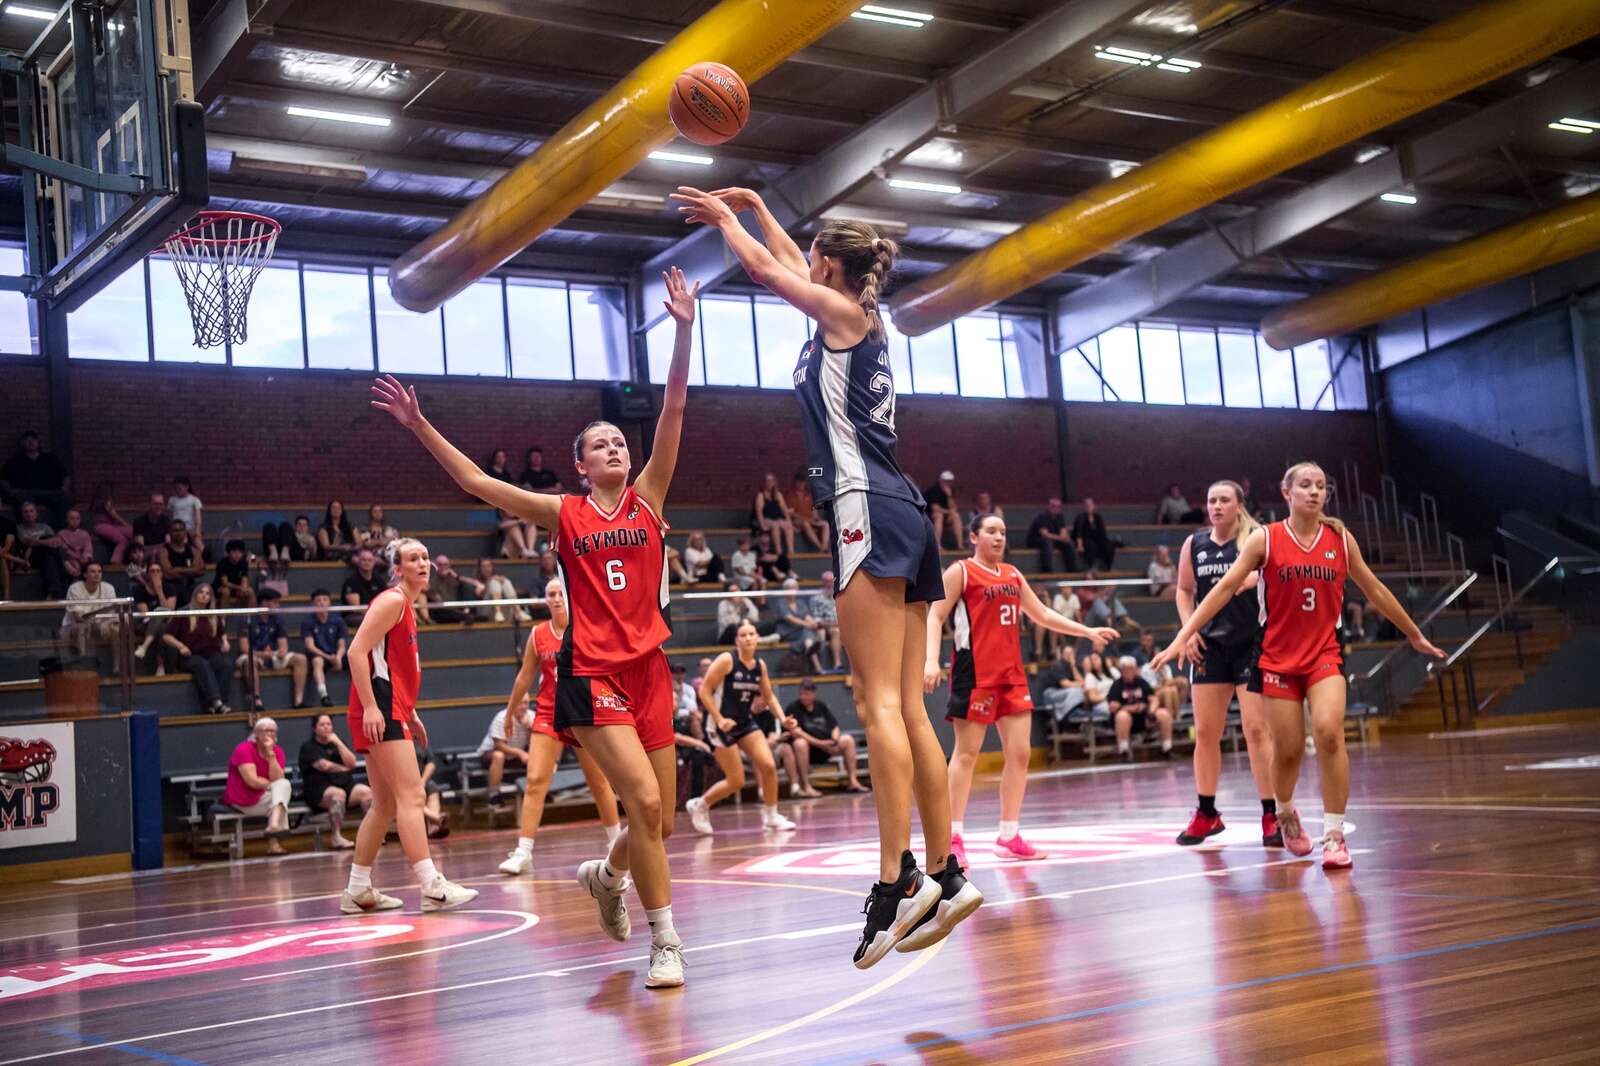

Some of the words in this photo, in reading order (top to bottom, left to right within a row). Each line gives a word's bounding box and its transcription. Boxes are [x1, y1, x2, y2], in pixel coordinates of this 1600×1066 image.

[573, 528, 648, 557] SEYMOUR
[605, 559, 627, 591] 6
[1278, 565, 1337, 584] SEYMOUR
[1301, 587, 1316, 612] 3
[999, 604, 1017, 626] 21
